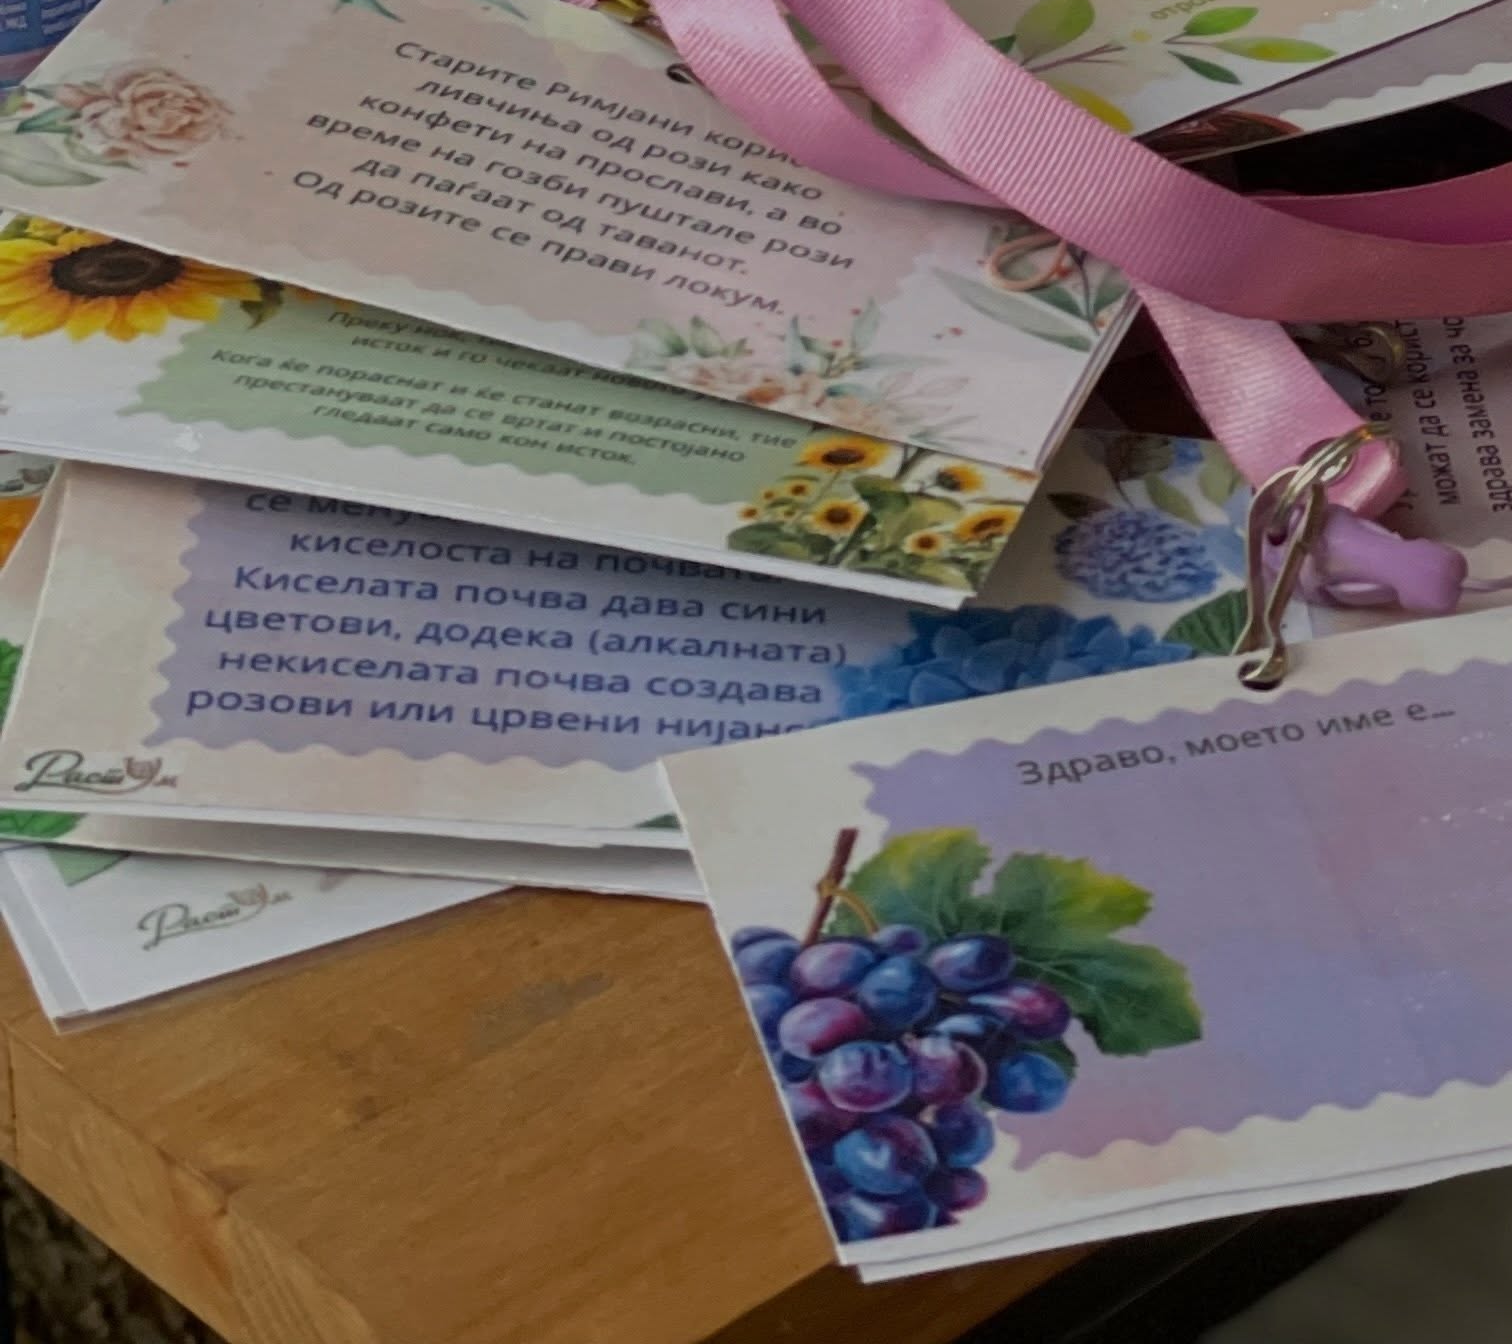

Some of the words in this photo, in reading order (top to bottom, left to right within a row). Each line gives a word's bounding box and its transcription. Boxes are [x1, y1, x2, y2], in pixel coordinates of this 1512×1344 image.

[395, 42, 537, 90] Старите
[546, 82, 695, 137] Римјани
[359, 96, 514, 145] конфети
[521, 139, 567, 161] на
[576, 154, 754, 216] прослави,
[765, 207, 787, 222] а
[798, 215, 842, 235] во
[416, 81, 582, 134] ливчиња
[592, 129, 636, 154] од
[641, 143, 731, 178] рози
[741, 171, 823, 201] како
[306, 114, 422, 152] време
[430, 146, 475, 167] на
[484, 161, 589, 199] гозби
[597, 193, 755, 244] пуштале
[762, 238, 855, 270] рози
[351, 159, 401, 178] да
[410, 172, 535, 214] паѓаат
[542, 209, 586, 234] од
[599, 222, 748, 275] таванот.
[293, 171, 344, 199] Од
[348, 189, 481, 232] розите
[491, 226, 531, 246] се
[541, 240, 656, 281] прави
[663, 275, 784, 314] локум.
[352, 336, 424, 355] исток
[432, 346, 451, 358] и
[457, 349, 487, 364] го
[1395, 320, 1432, 384] корист
[1450, 344, 1475, 365] за
[211, 349, 274, 369] Кога
[278, 355, 310, 373] ќе
[316, 363, 444, 392] пораснат
[450, 384, 467, 396] и
[474, 384, 505, 404] ќе
[511, 394, 604, 417] станат
[608, 409, 740, 442] возрасни,
[751, 431, 798, 450] тие
[233, 374, 420, 410] престануваат
[421, 403, 457, 417] да
[464, 407, 495, 421] се
[500, 414, 580, 435] вртат
[583, 426, 603, 439] и
[608, 431, 746, 463] постојано
[1413, 389, 1436, 410] се
[1419, 415, 1449, 438] да
[1457, 369, 1495, 441] замена
[313, 404, 421, 430] гледаат
[424, 423, 493, 442] само
[499, 433, 548, 450] кон
[555, 443, 638, 466] исток.
[244, 493, 293, 513] се
[1425, 442, 1460, 506] можат
[290, 533, 512, 565] киселоста
[528, 549, 579, 571] на
[234, 565, 438, 601] Киселата
[455, 583, 587, 611] почва
[601, 594, 704, 619] дава
[719, 600, 827, 625] сини
[205, 608, 402, 641] цветови,
[414, 621, 573, 649] додека
[589, 628, 847, 666] (алкалната)
[218, 652, 479, 685] некиселата
[495, 667, 630, 693] почва
[645, 676, 822, 705] создава
[186, 690, 353, 716] розови
[369, 699, 454, 723] или
[471, 707, 640, 734] црвени
[1017, 744, 1177, 786] Здраво,
[1184, 721, 1305, 759] моето
[1316, 706, 1395, 738] име
